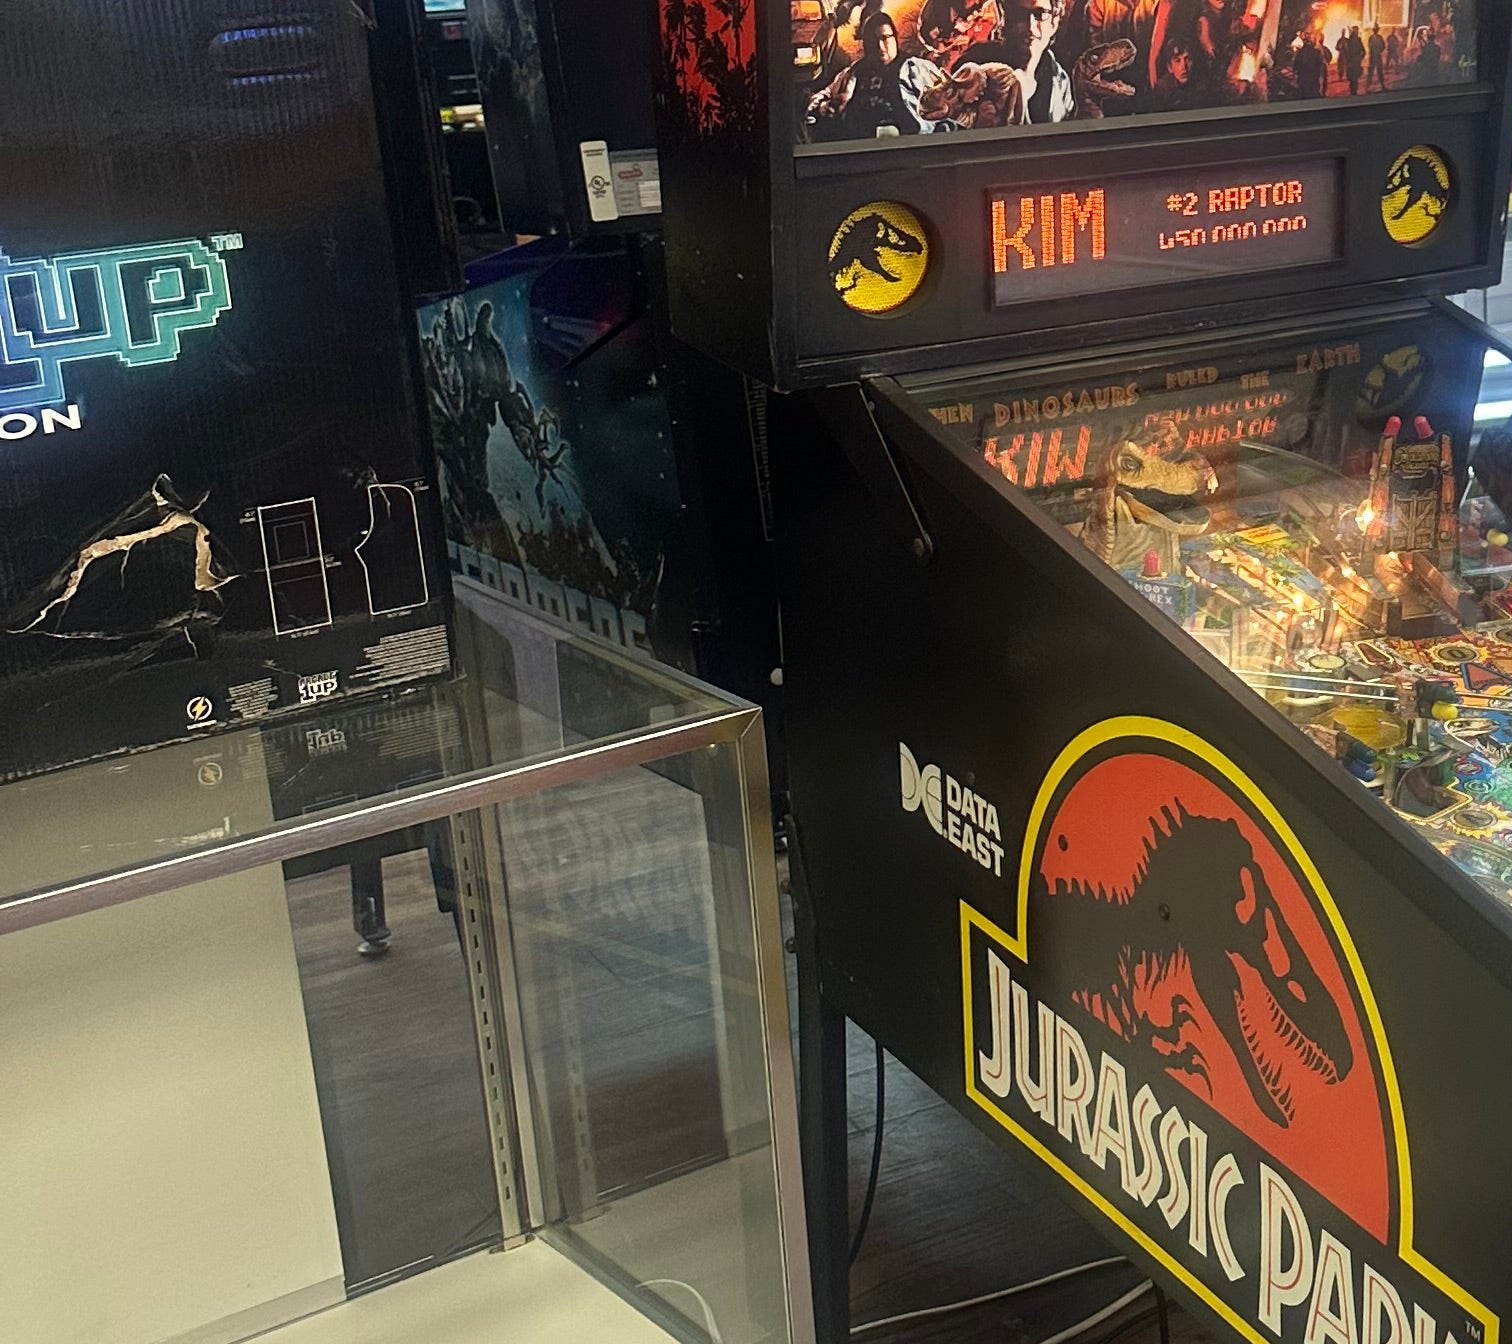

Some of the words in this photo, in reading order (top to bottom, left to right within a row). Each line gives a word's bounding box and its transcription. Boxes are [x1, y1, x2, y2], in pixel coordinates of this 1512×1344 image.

[992, 188, 1106, 273] KIM
[1167, 191, 1199, 217] #2
[1208, 180, 1303, 214] RAPTOR
[0, 404, 82, 441] ON
[994, 382, 1140, 427] DINOSAURS
[1165, 366, 1220, 388] RULED
[1239, 370, 1271, 389] THE
[1295, 344, 1362, 375] EARTH
[946, 774, 1001, 842] DATA
[947, 810, 1005, 877] EAST
[976, 949, 1248, 1282] JURASSIC
